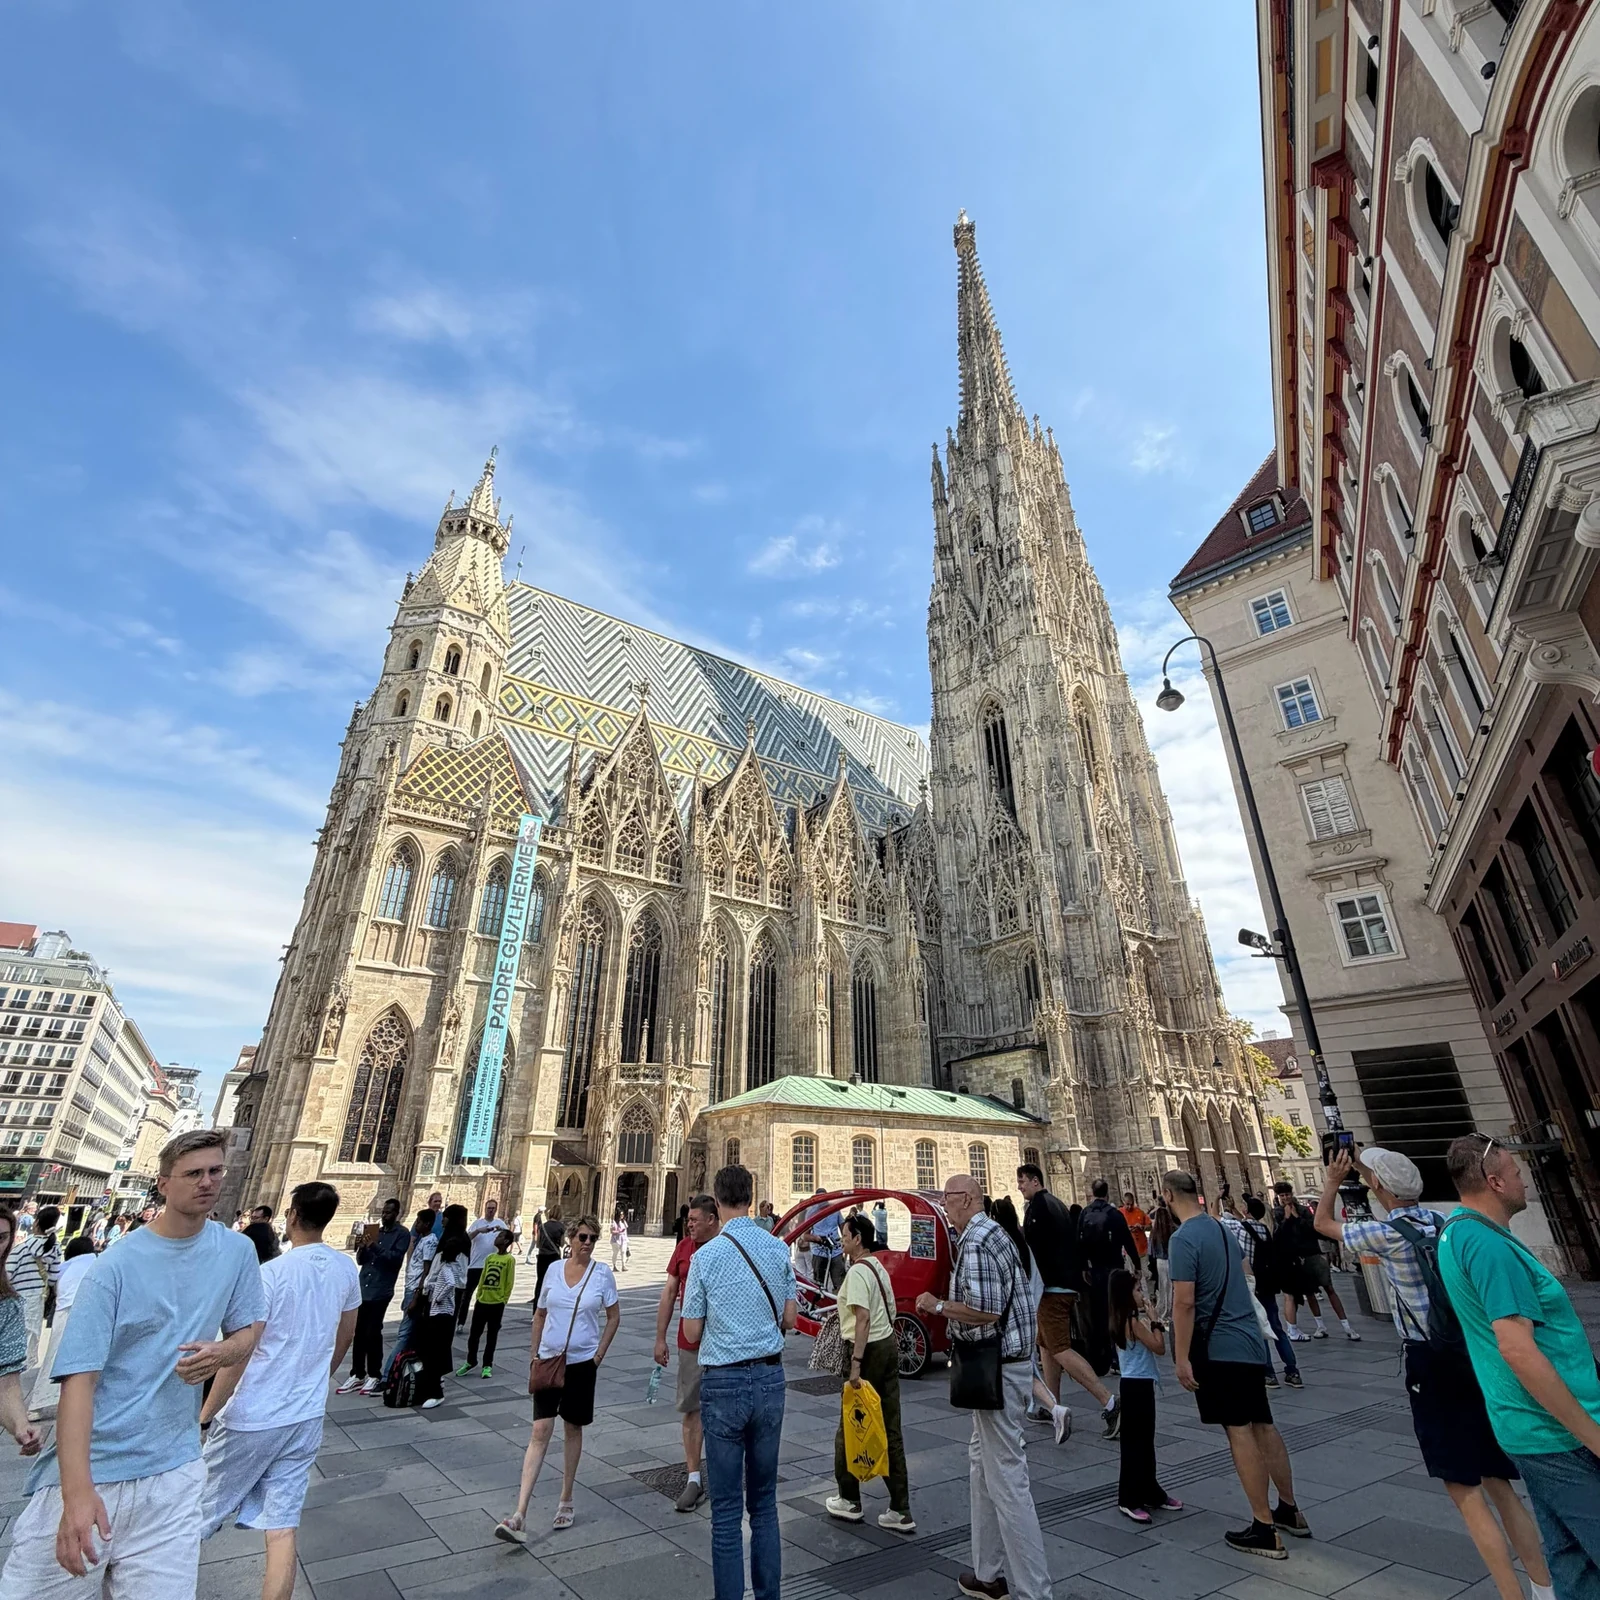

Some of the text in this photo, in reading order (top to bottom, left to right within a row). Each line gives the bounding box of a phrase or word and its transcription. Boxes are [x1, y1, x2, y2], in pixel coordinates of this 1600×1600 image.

[488, 960, 515, 1030] PADRE
[471, 1096, 484, 1136] SEEBÜHNE
[478, 1056, 491, 1096] MÖRBISCH
[481, 1108, 491, 1137] TICKETS
[488, 1058, 499, 1103] martinus.at
